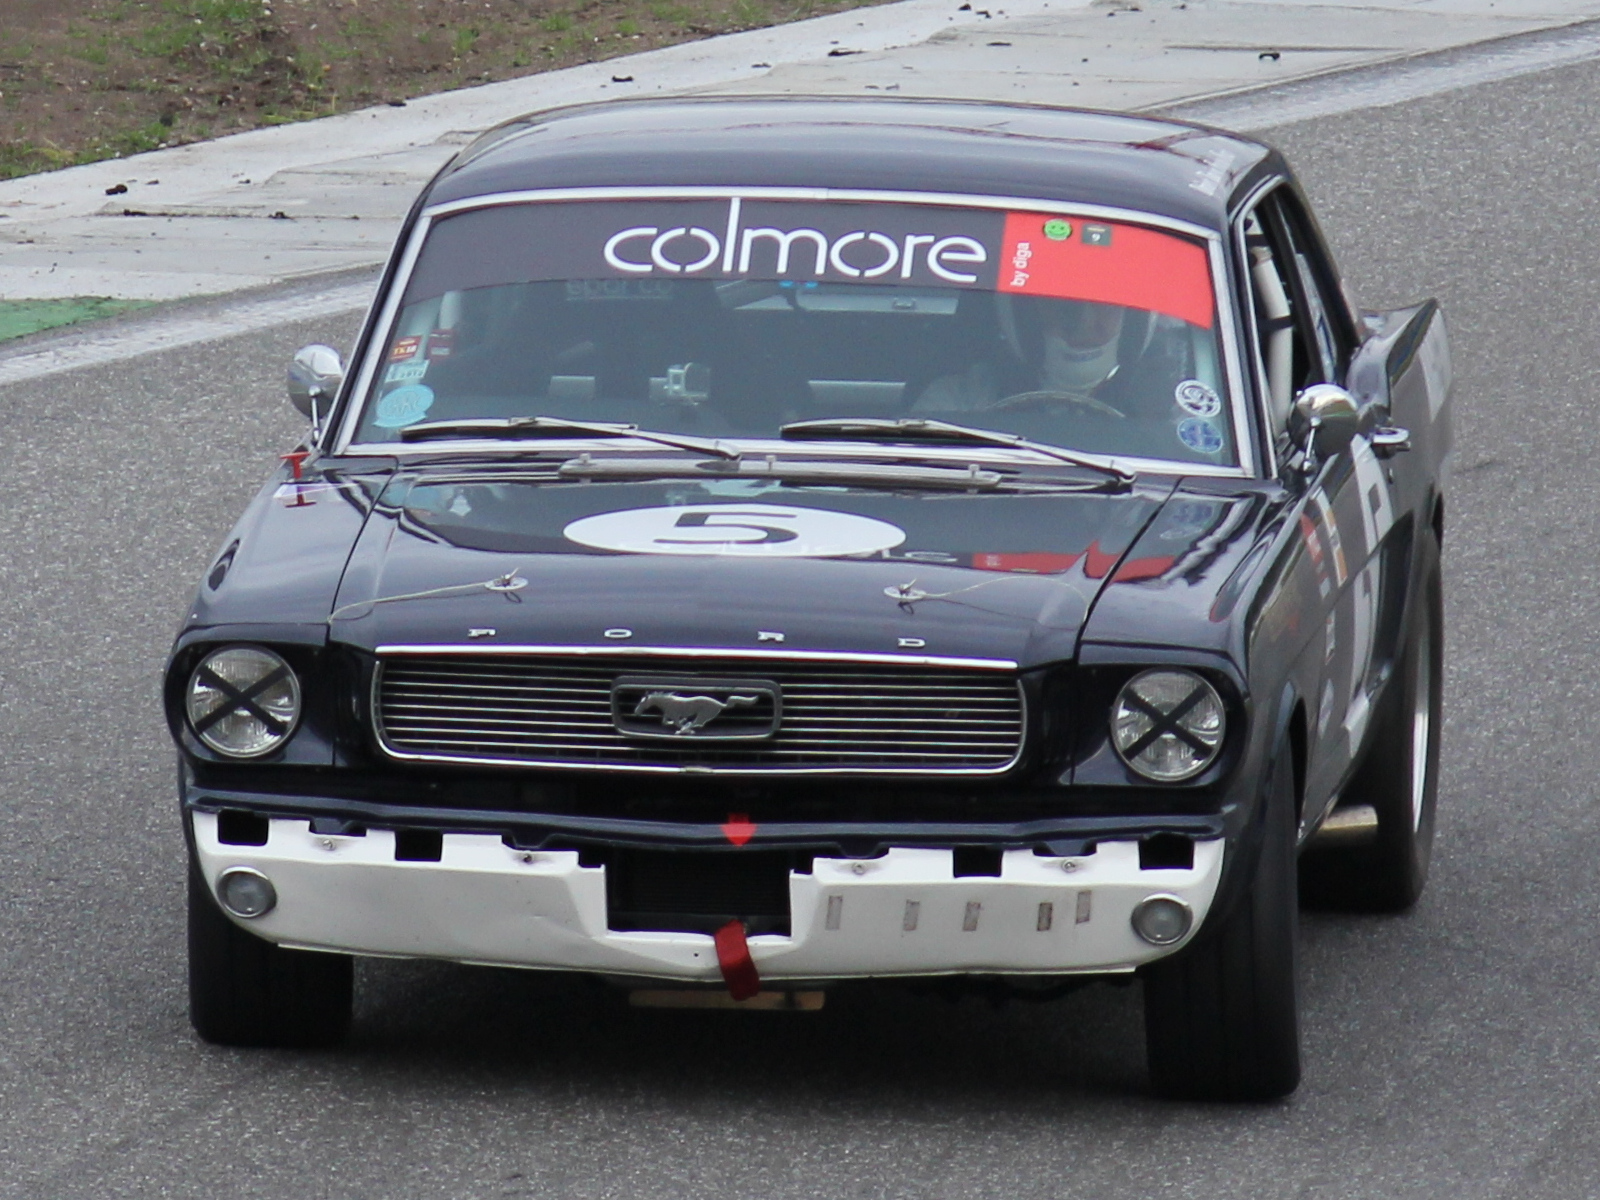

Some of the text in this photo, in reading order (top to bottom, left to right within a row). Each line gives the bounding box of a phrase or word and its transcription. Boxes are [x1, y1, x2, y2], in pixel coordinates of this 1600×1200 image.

[603, 197, 987, 283] colmore
[1011, 242, 1032, 287] by diga
[652, 512, 799, 545] 5
[467, 627, 926, 648] FORD
